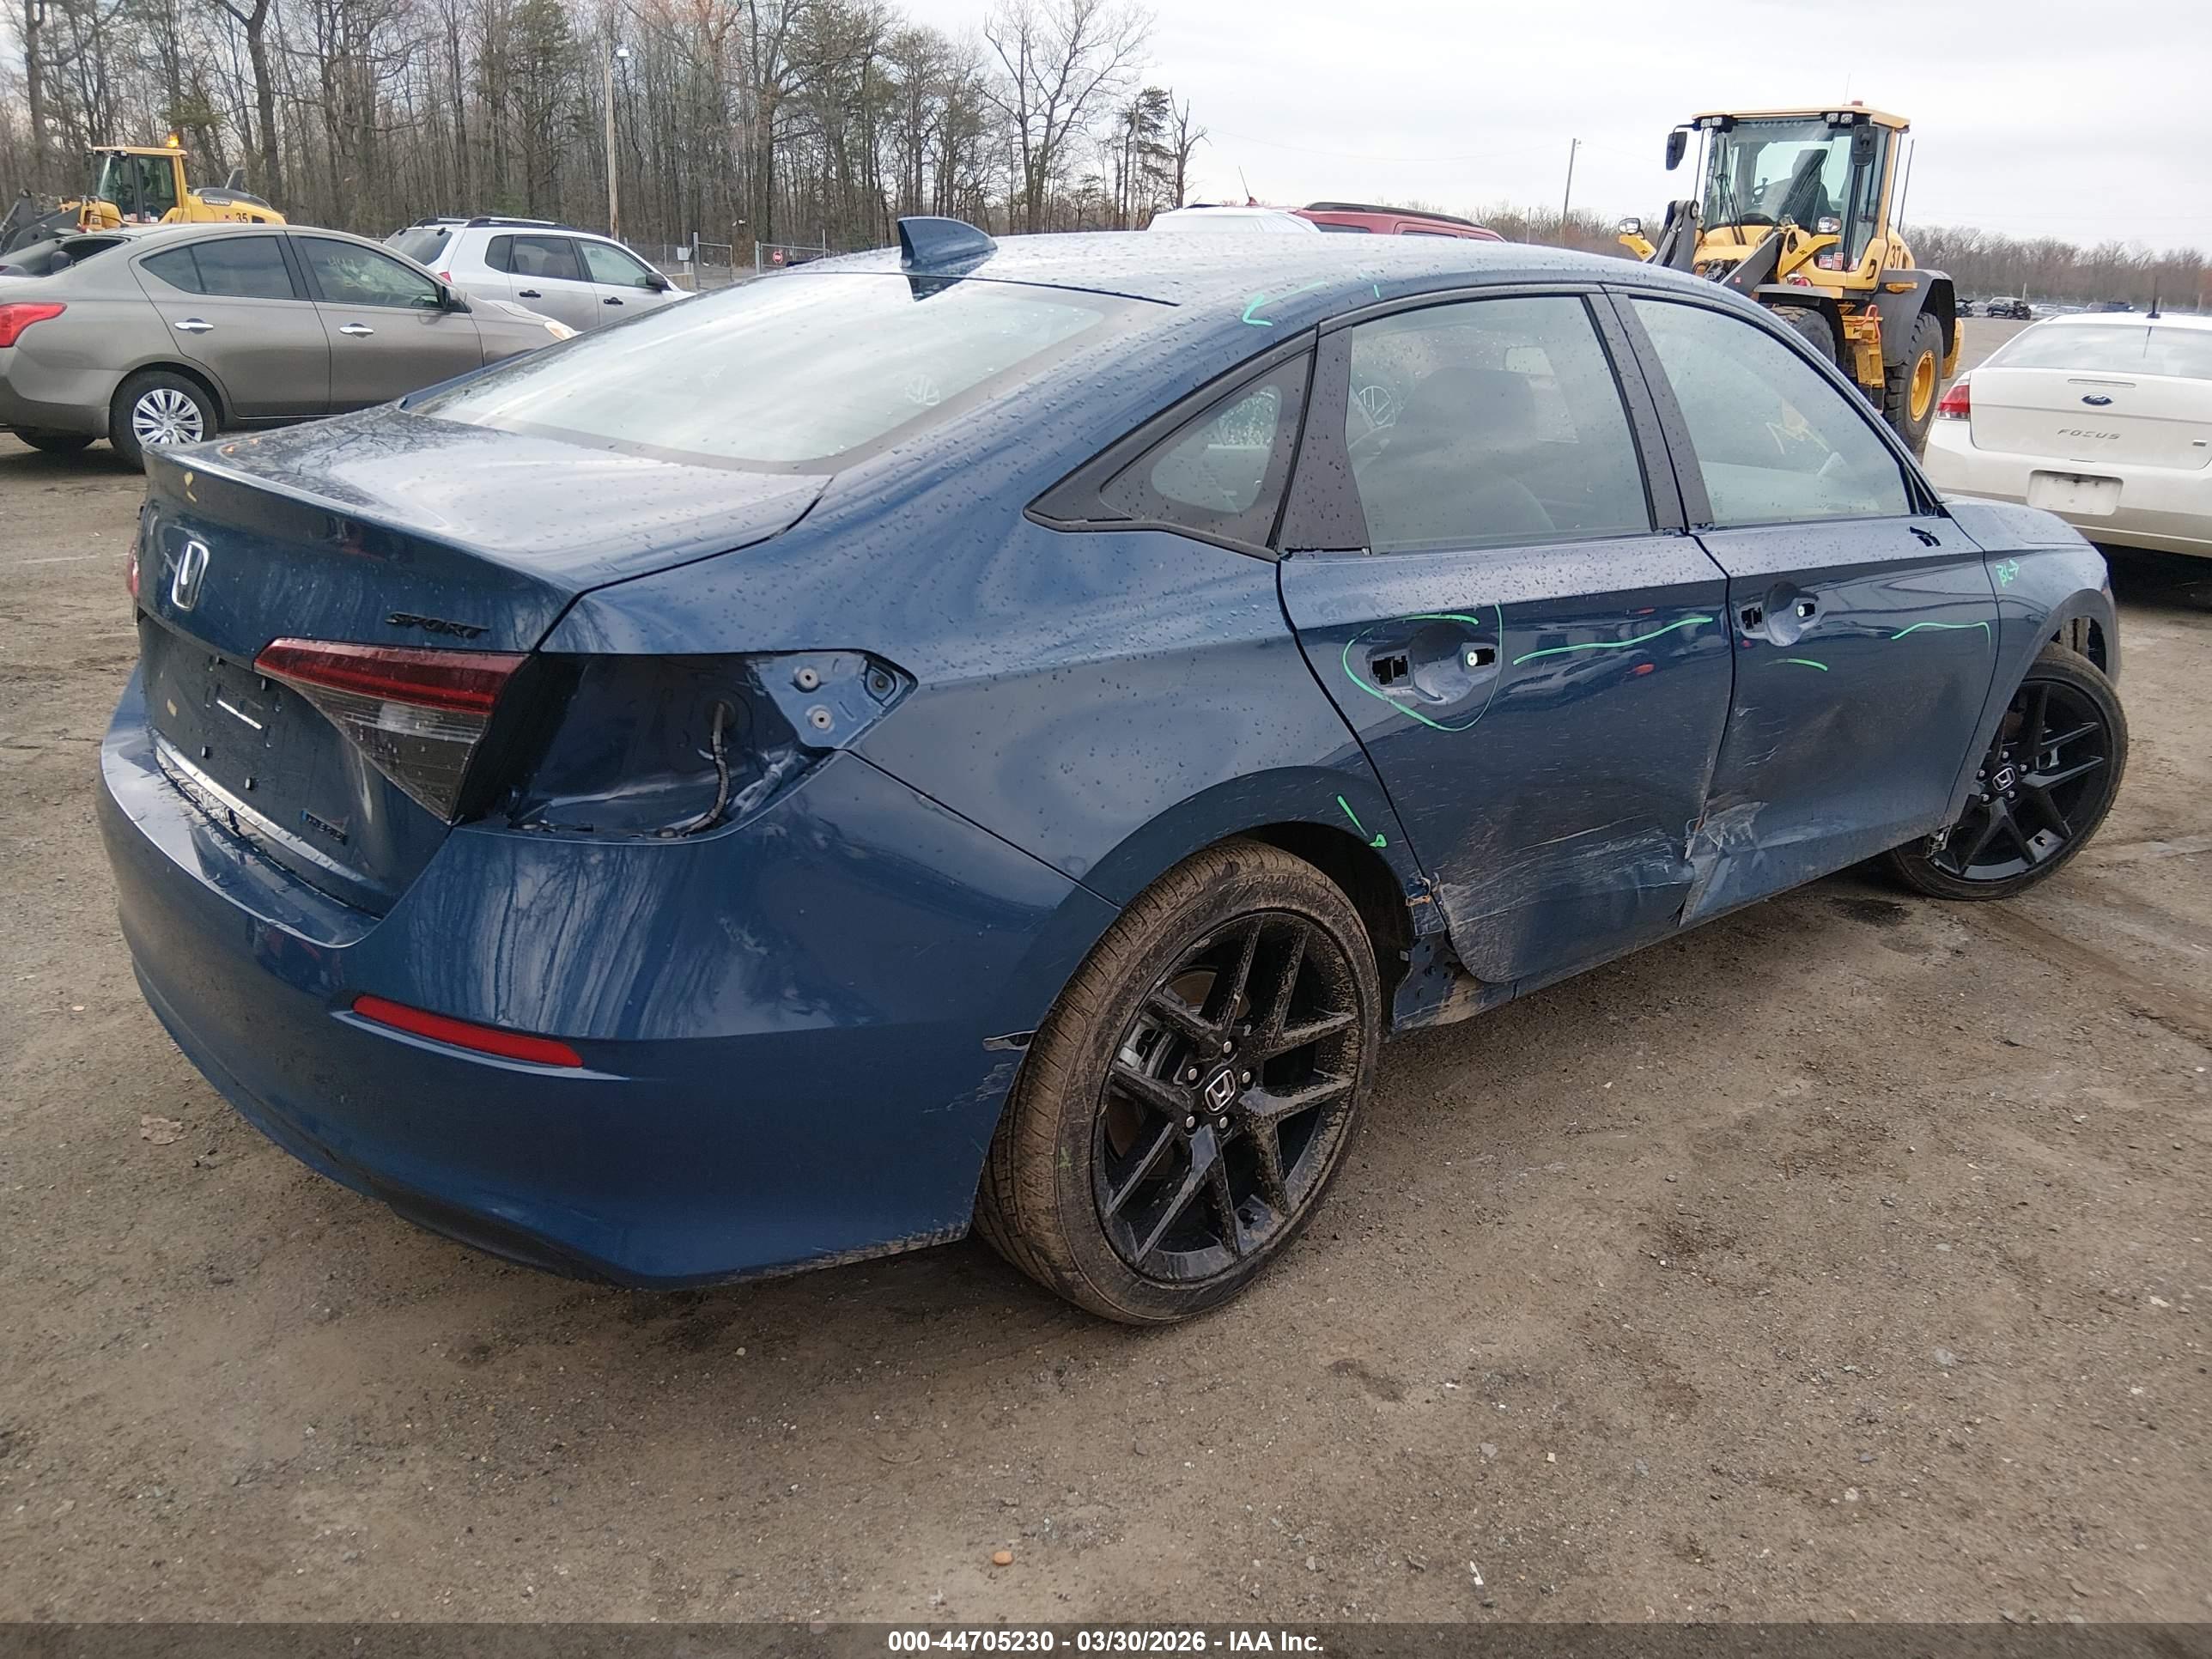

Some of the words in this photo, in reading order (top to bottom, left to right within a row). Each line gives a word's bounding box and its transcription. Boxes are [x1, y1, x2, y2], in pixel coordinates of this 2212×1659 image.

[235, 212, 248, 224] 35
[1889, 244, 1902, 270] 37
[2057, 428, 2122, 441] FOCUS
